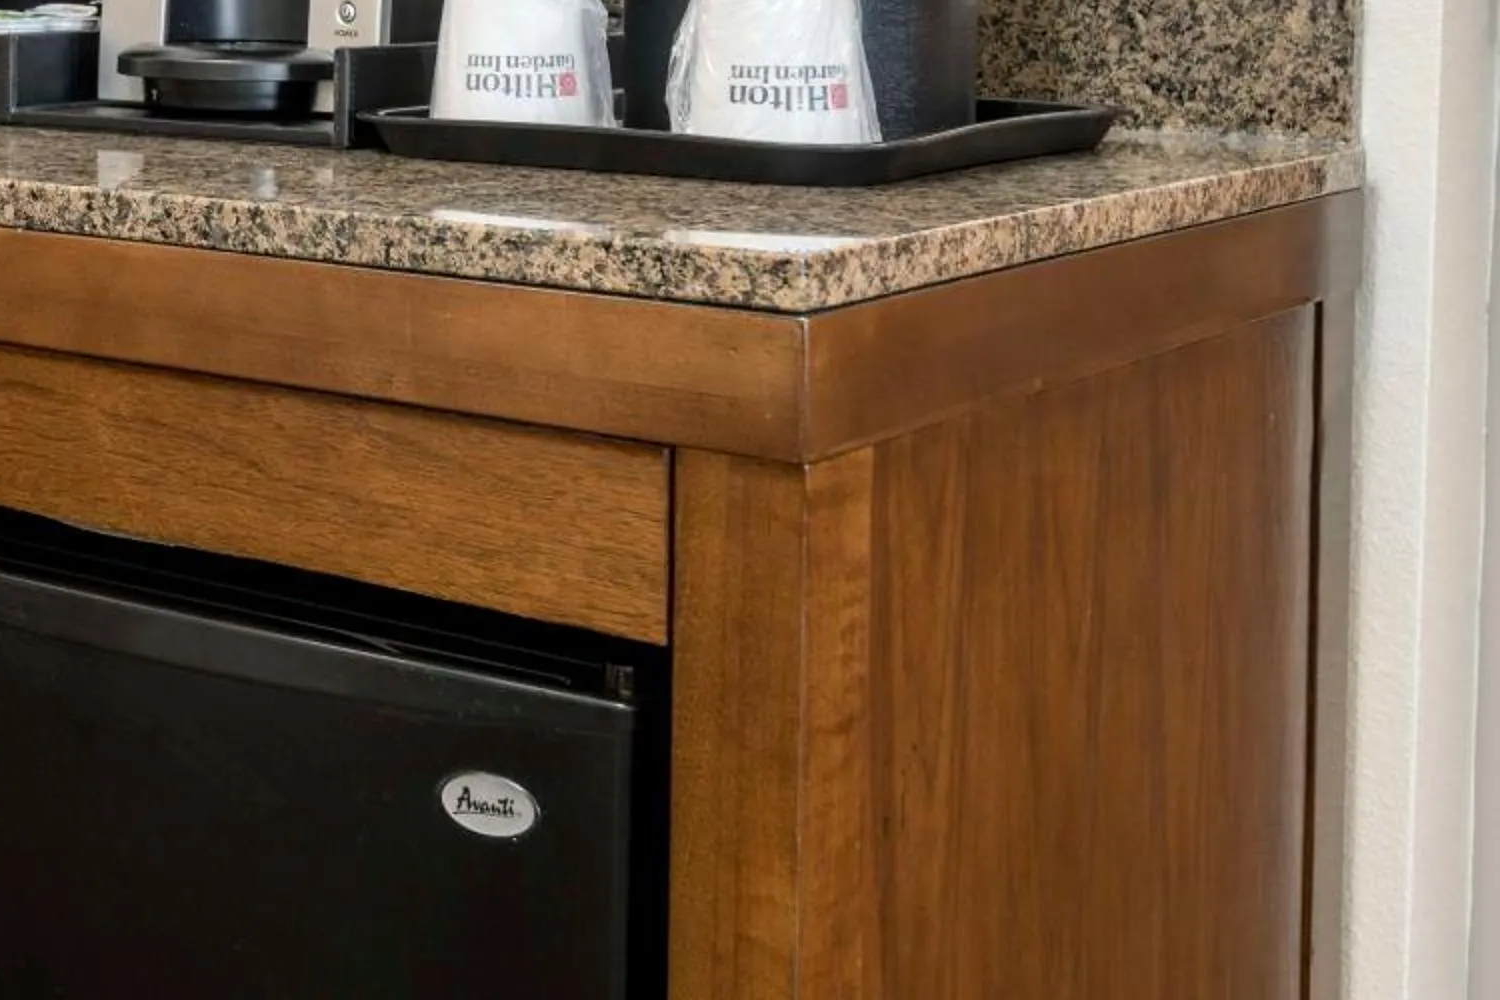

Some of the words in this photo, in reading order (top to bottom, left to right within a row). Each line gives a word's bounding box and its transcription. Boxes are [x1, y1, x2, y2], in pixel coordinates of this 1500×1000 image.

[467, 54, 501, 72] Inn
[730, 64, 770, 84] Inn
[466, 72, 558, 98] Hilton
[729, 85, 830, 111] Hilton
[453, 785, 516, 818] Avanti
